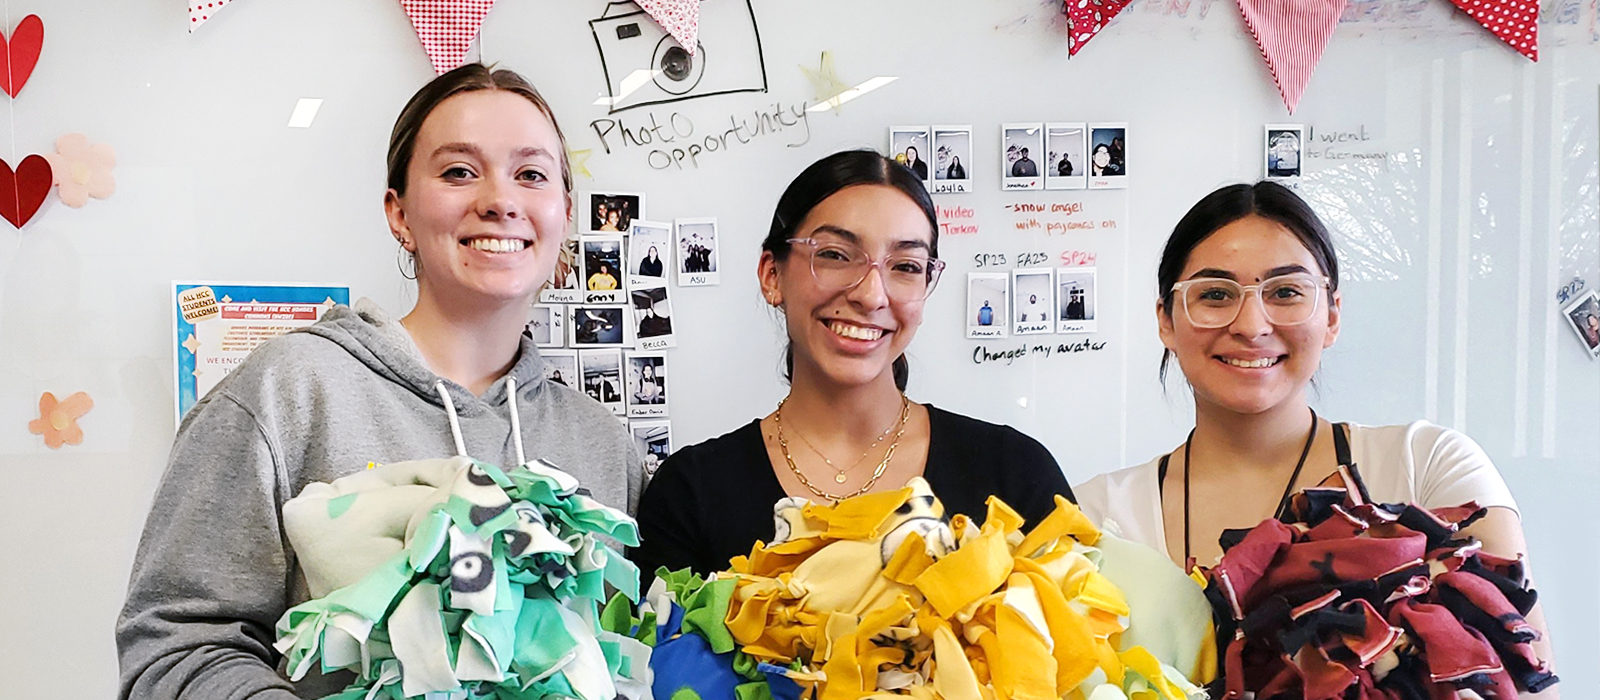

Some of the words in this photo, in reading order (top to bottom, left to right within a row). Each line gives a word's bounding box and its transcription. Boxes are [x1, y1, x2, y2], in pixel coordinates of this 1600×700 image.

[1320, 124, 1371, 143] went
[943, 205, 975, 219] video
[1051, 202, 1083, 216] angel
[1016, 218, 1042, 230] with
[1101, 219, 1117, 229] on
[1060, 250, 1098, 266] SP24
[689, 275, 706, 285] ASU
[972, 343, 1027, 365] Changed
[1032, 343, 1052, 358] my
[1057, 338, 1108, 353] avatar
